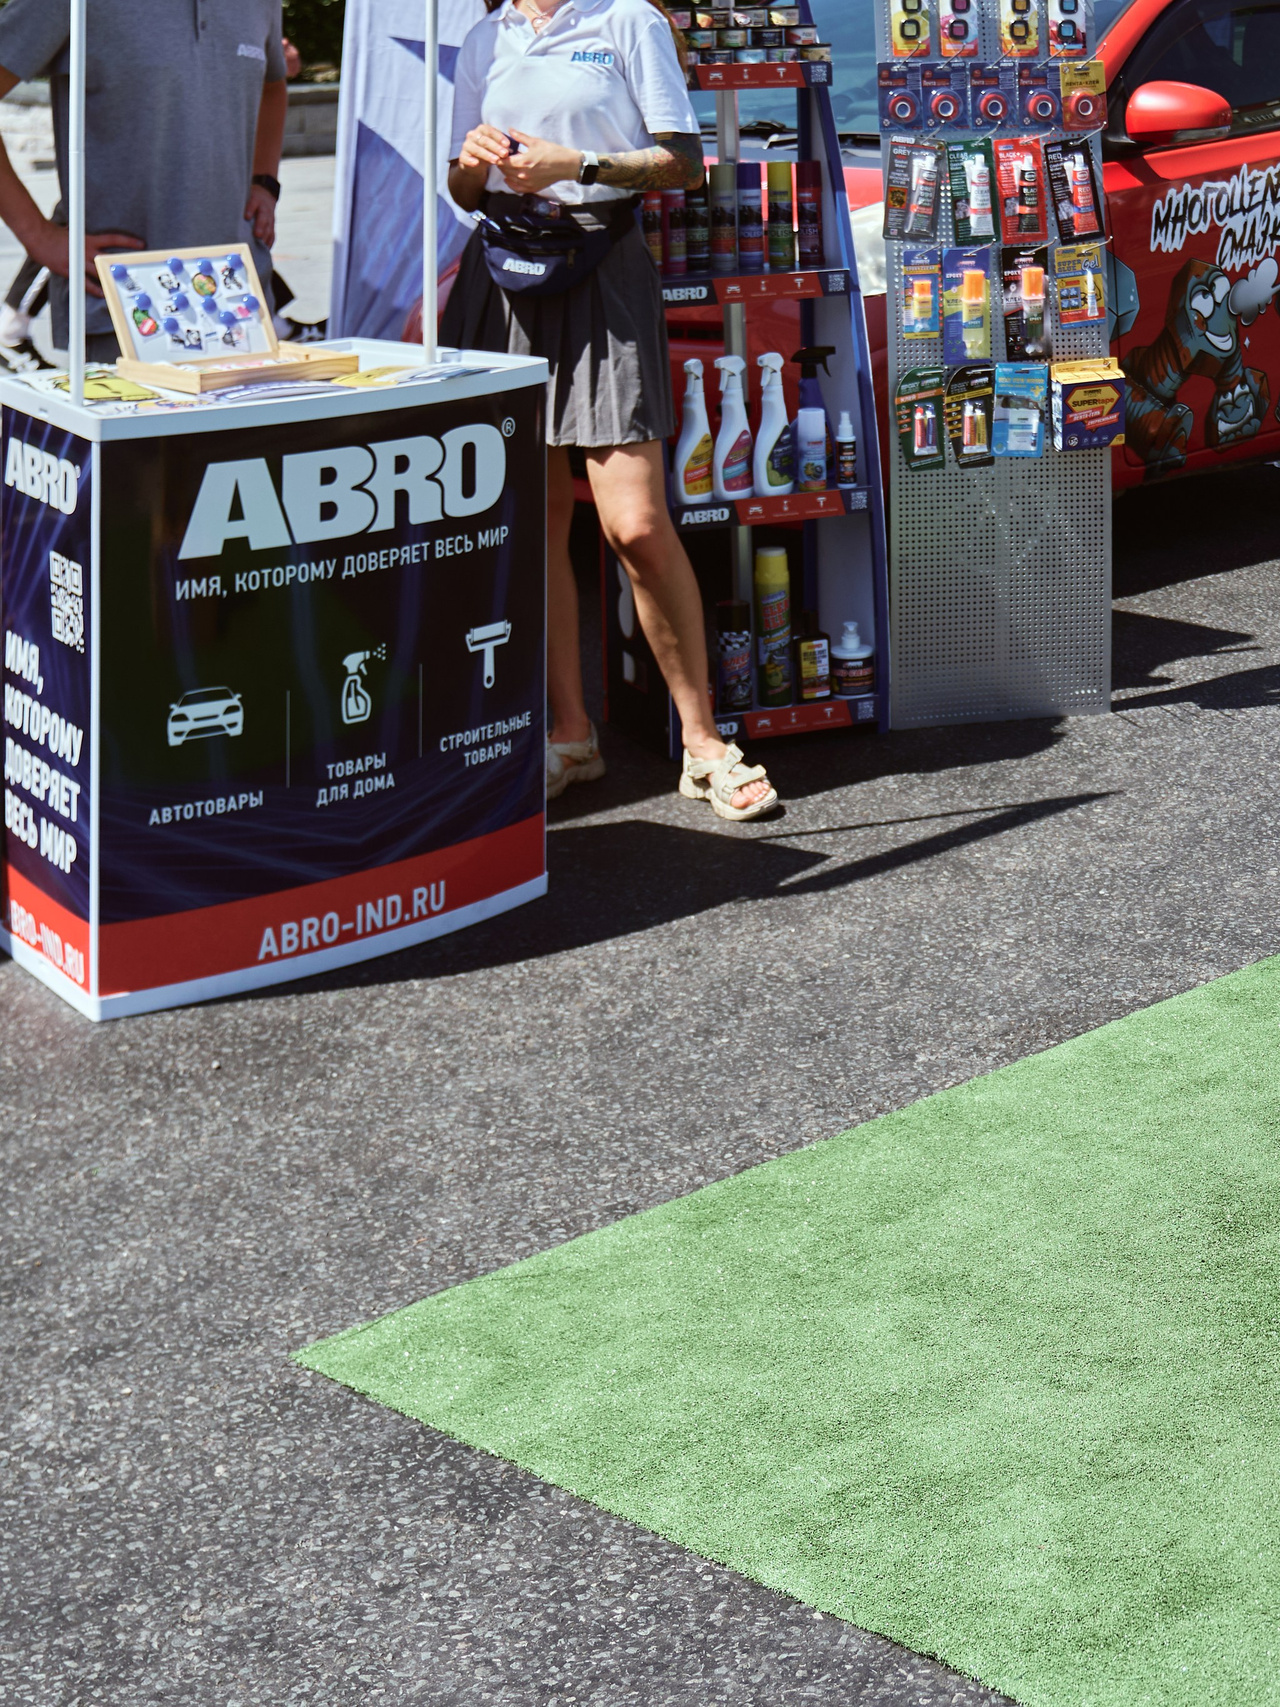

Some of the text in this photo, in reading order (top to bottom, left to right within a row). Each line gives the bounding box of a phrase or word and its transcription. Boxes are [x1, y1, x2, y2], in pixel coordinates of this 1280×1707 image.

[571, 51, 615, 67] ABRO
[893, 148, 911, 156] GREY
[502, 257, 546, 276] ABRO
[1081, 255, 1099, 271] Gel
[662, 285, 708, 301] ABRO
[5, 437, 80, 515] ABRO
[681, 508, 731, 525] ABRO
[175, 525, 509, 601] ИМЯ, КОТОРОМУ ДОВЕРЯЕТ ВЕСЬ МИР
[4, 630, 44, 695] ИМЯ,
[4, 682, 84, 767] КОТОРОМУ
[440, 711, 532, 752] СТРОИТЕЛЬНЫЕ
[717, 721, 739, 736] RO
[327, 753, 387, 780] ТОВАРЫ
[464, 740, 512, 768] ТОВАРЫ
[4, 736, 81, 823] ДОВЕРЯЕТ
[316, 773, 395, 808] ДЛЯ ДОМА
[148, 790, 264, 826] АВТОТОВАРЫ
[4, 787, 77, 874] ВЕСЬ МИР
[257, 880, 446, 961] ABRO-IND.RU
